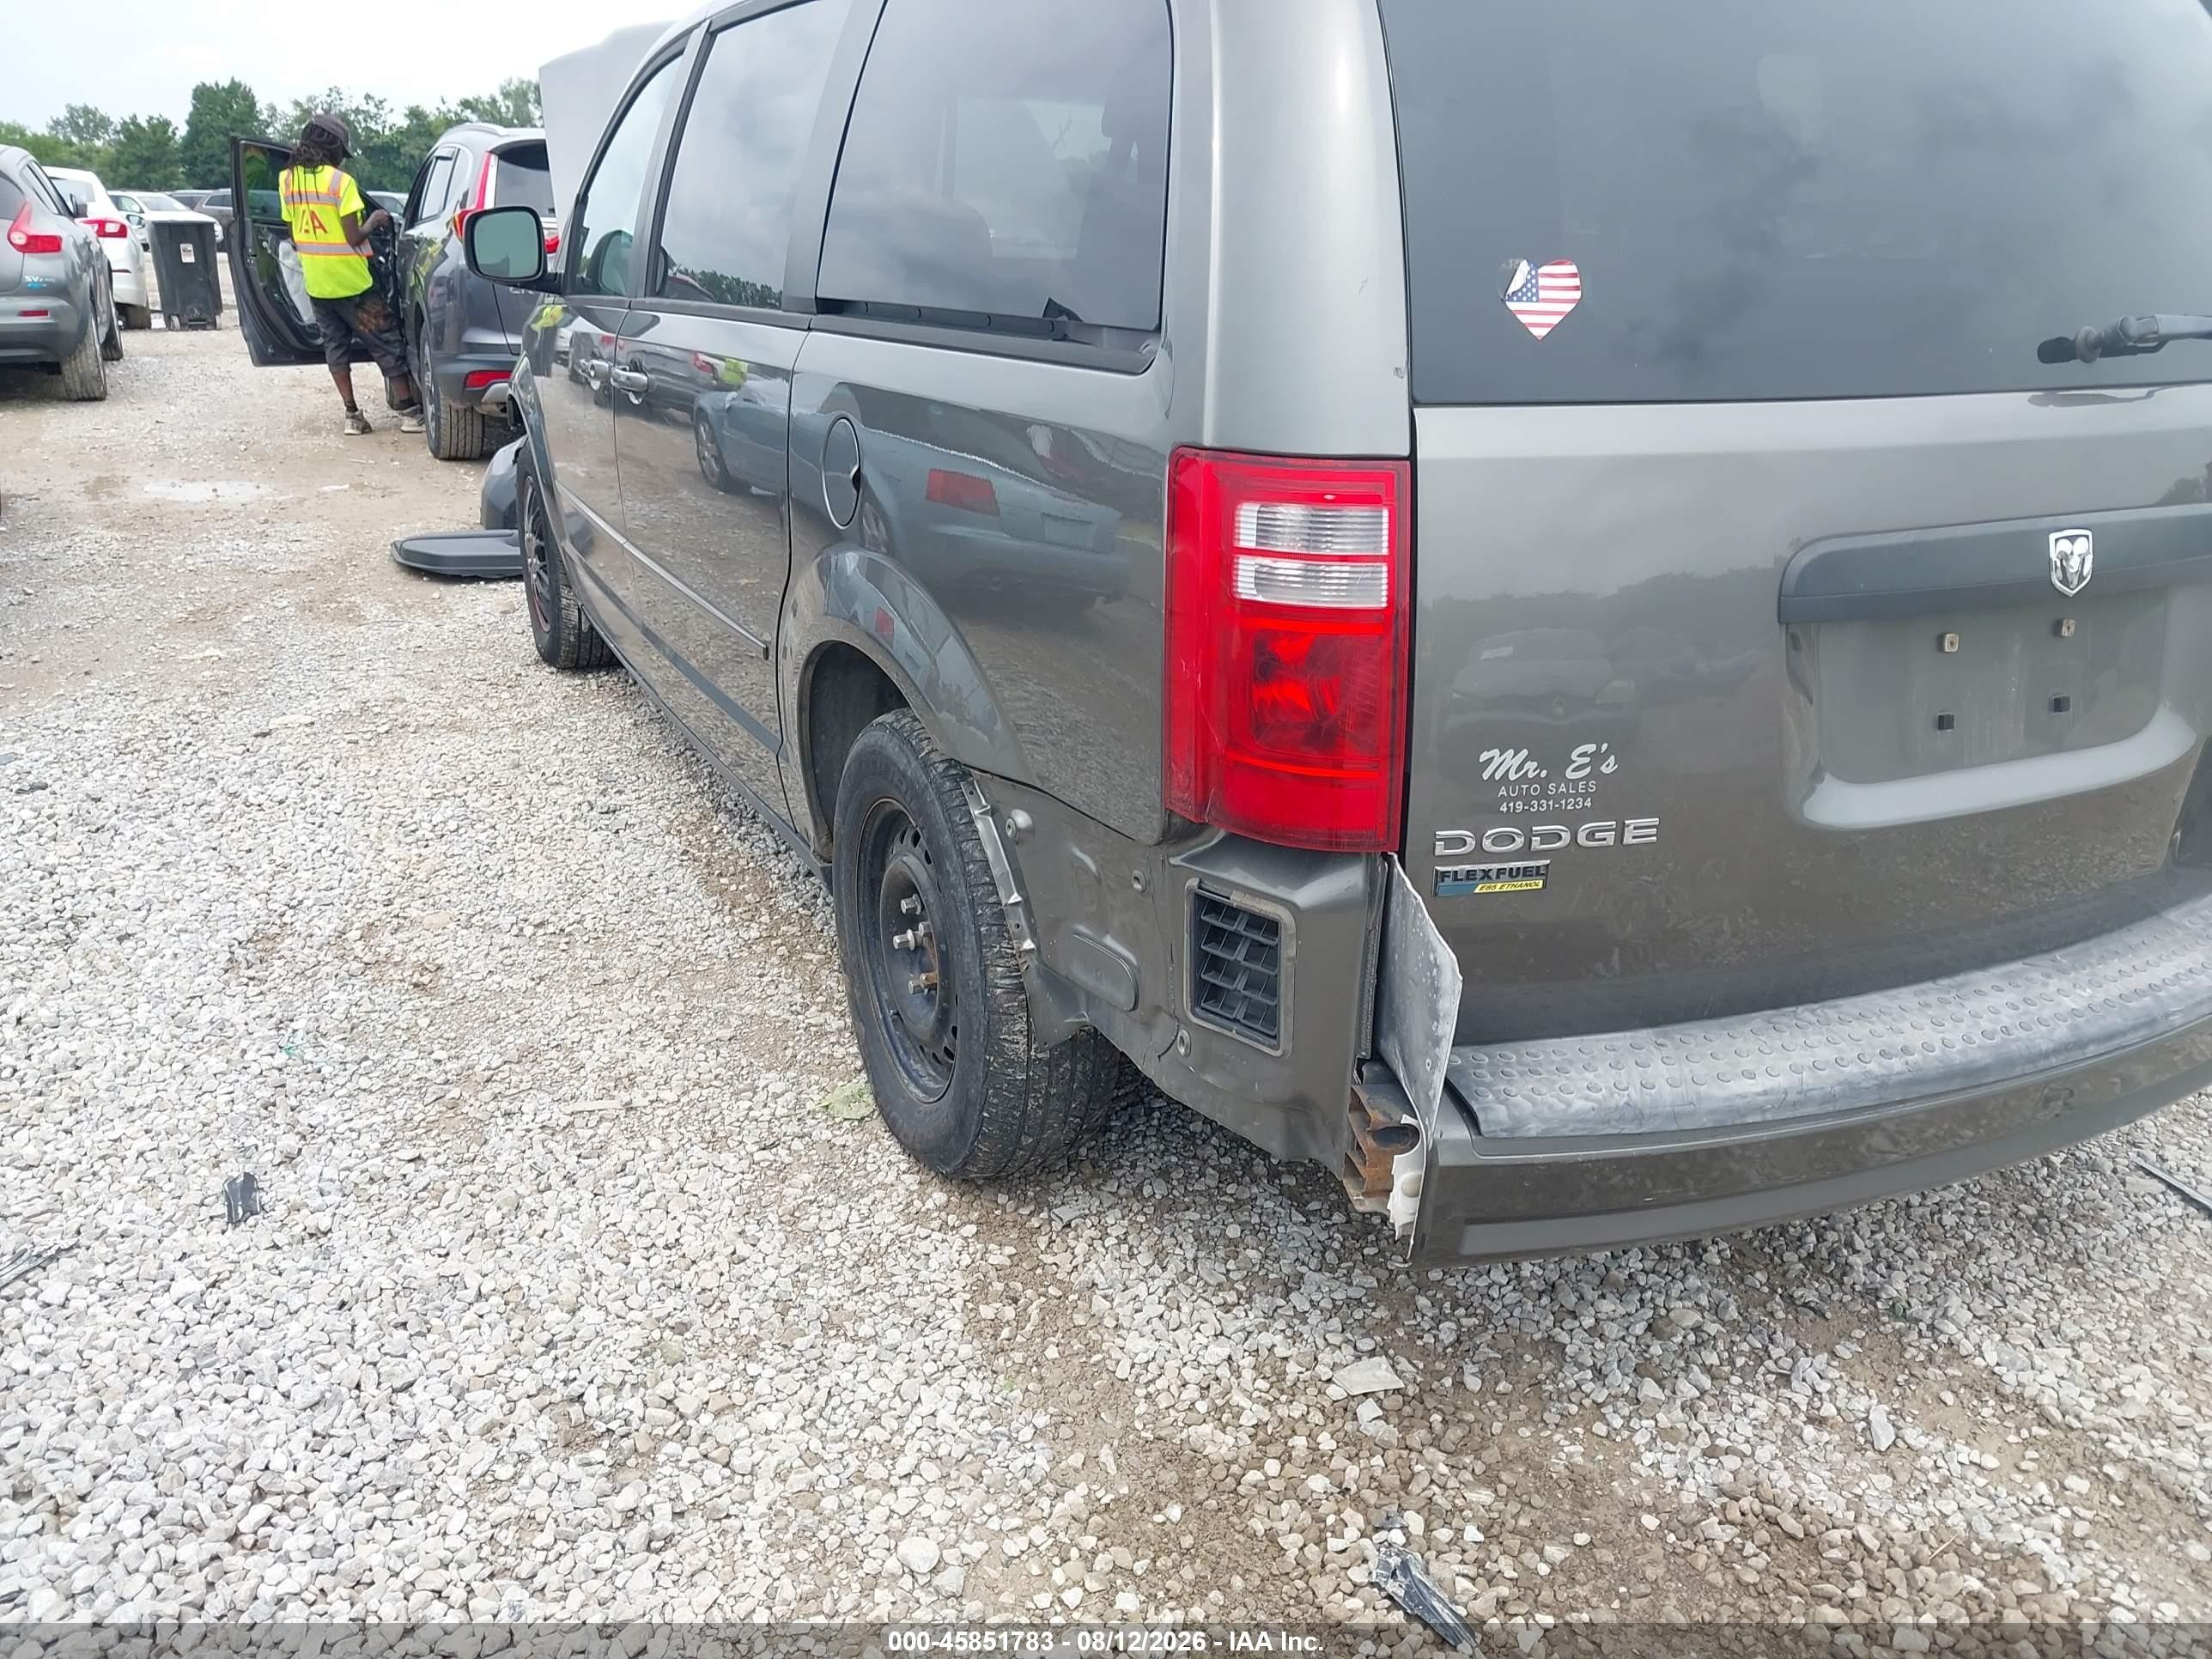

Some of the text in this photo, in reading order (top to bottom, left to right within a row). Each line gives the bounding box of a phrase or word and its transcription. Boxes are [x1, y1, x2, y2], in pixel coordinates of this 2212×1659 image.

[1479, 742, 1619, 781] Mr. E's
[1498, 780, 1597, 799] AUTO SALES
[1499, 796, 1592, 814] 419-331-1234
[1434, 817, 1661, 857] DODGE
[1498, 880, 1541, 890] ETHANOL
